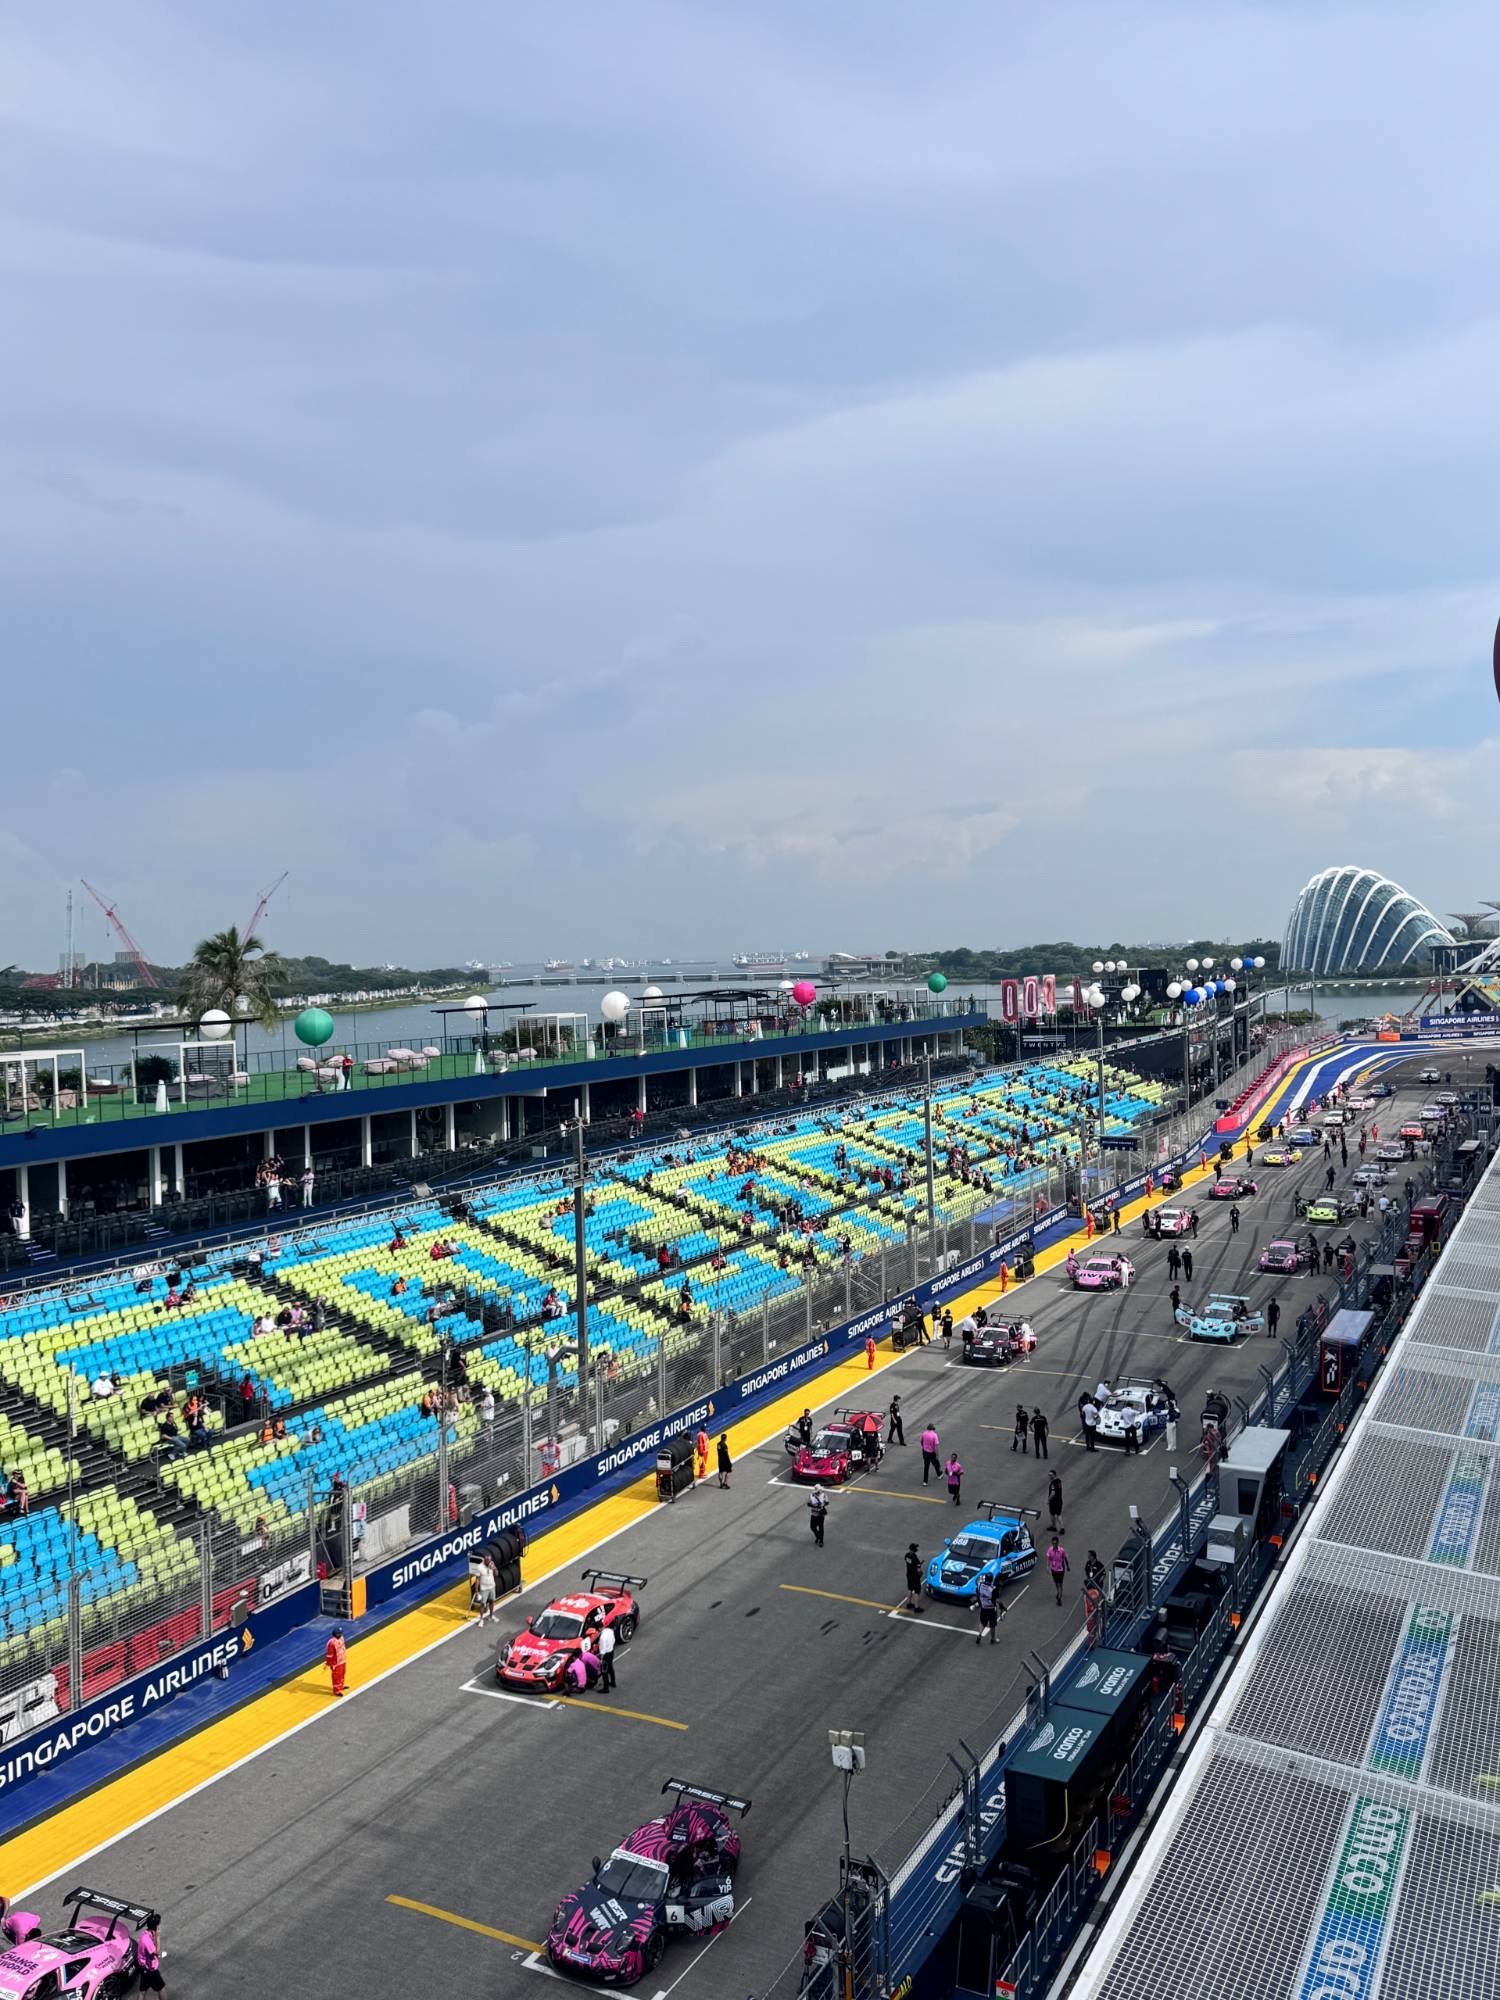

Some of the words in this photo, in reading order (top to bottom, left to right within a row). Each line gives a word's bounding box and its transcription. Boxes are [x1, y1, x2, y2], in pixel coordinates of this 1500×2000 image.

[1429, 1018, 1466, 1026] SINGAPORE
[931, 1272, 960, 1295] SINGAPORE
[961, 1259, 982, 1278] AIRLINES
[848, 1311, 885, 1339] SINGAPORE
[742, 1362, 788, 1397] SINGAPORE
[790, 1343, 824, 1371] AIRLINES
[598, 1431, 660, 1476] SINGAPORE
[662, 1405, 708, 1441] AIRLINES
[391, 1526, 482, 1590] SINGAPORE
[486, 1489, 550, 1538] AIRLINES
[1099, 1667, 1126, 1694] aramco
[0, 1695, 134, 1789] SINGAPORE
[142, 1636, 239, 1706] AIRLINES
[1053, 1727, 1083, 1759] aramco
[668, 1781, 746, 1809] PORSCHE
[719, 1884, 732, 1893] YIP
[726, 1875, 732, 1884] 6
[671, 1911, 678, 1922] 6
[1, 1953, 39, 1970] CHANGE
